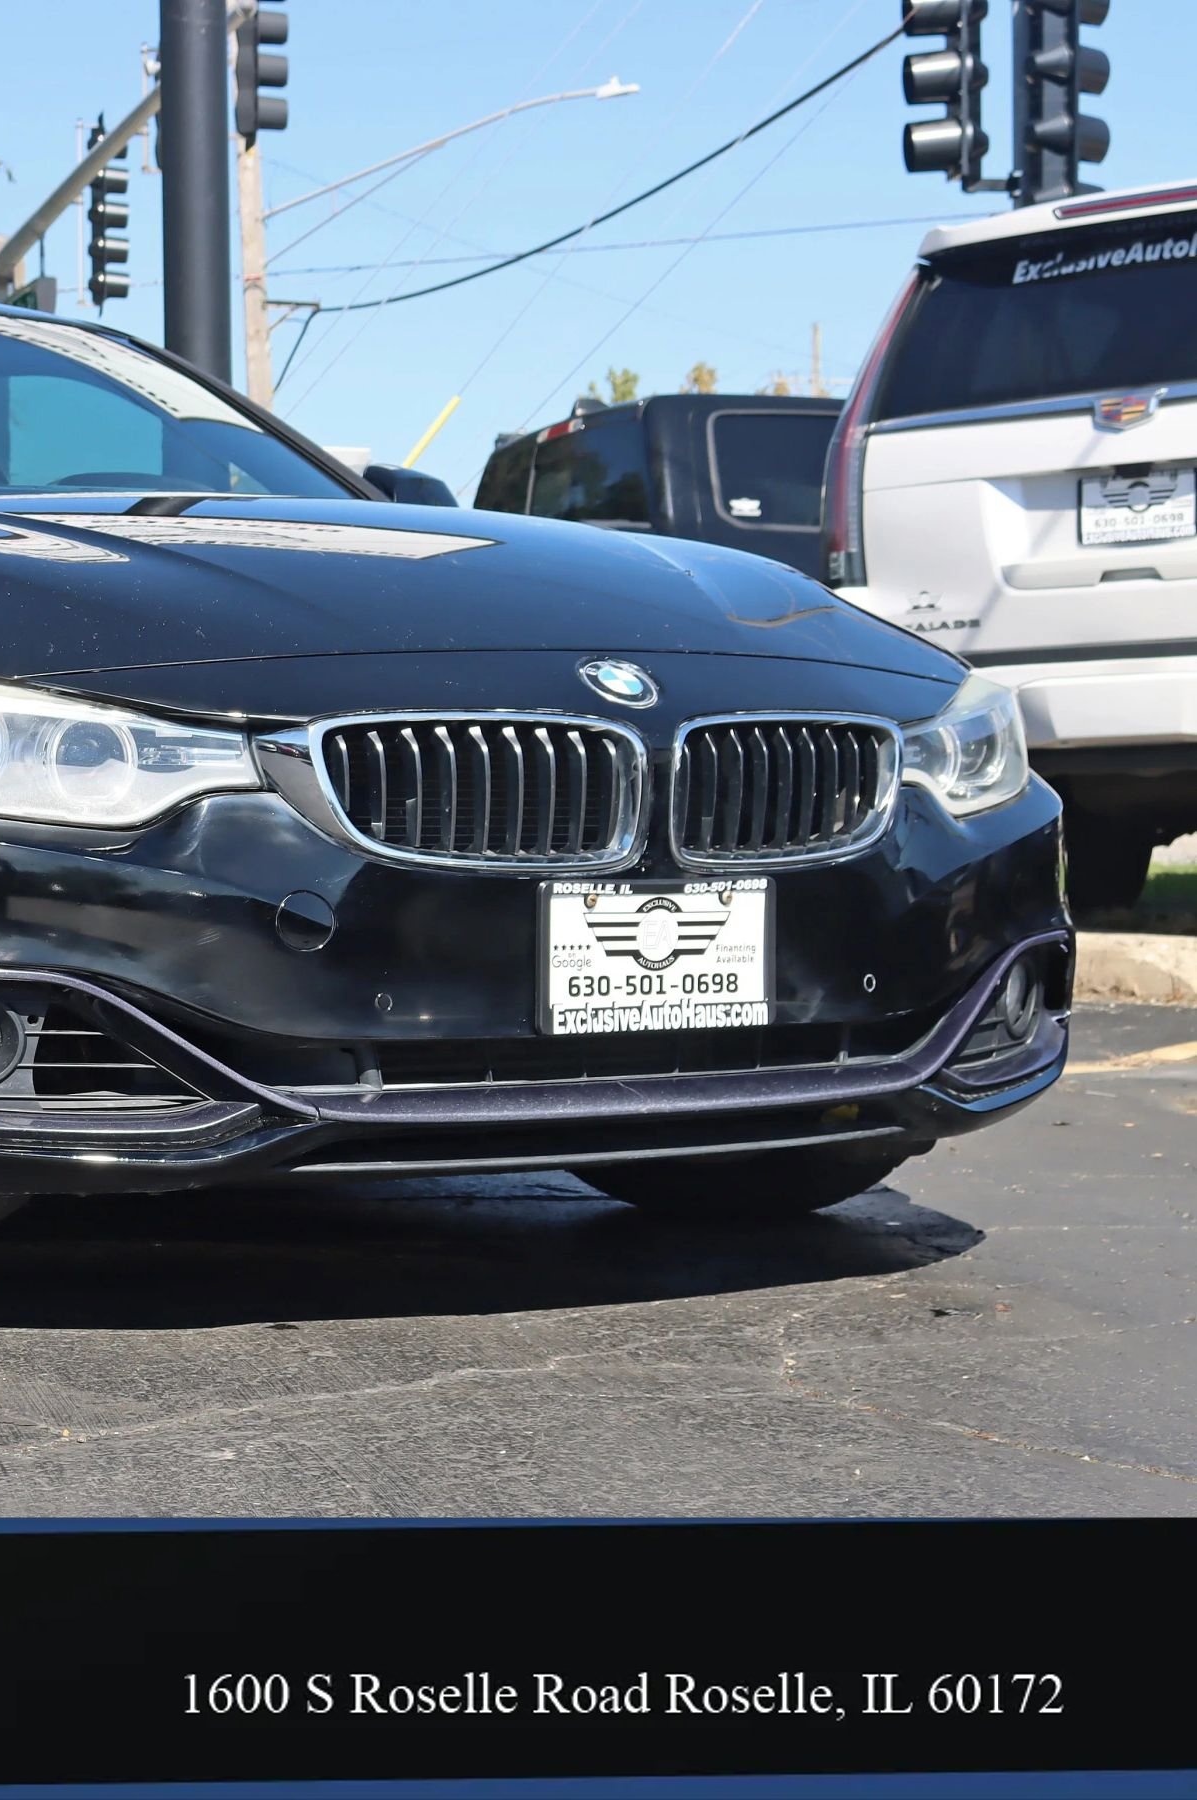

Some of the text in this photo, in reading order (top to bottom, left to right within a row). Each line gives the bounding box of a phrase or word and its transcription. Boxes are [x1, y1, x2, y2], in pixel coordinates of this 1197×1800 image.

[553, 883, 633, 895] ROSELLE, IL
[684, 879, 767, 894] 630-501-0698
[643, 899, 677, 912] EXCLUSIVE
[715, 944, 756, 954] Financing
[552, 955, 592, 971] Google
[638, 956, 676, 969] AUTOHAUS
[716, 955, 755, 964] Available
[568, 973, 739, 997] 630-501-0698
[553, 999, 769, 1034] ExclusiveAutoHaus.com
